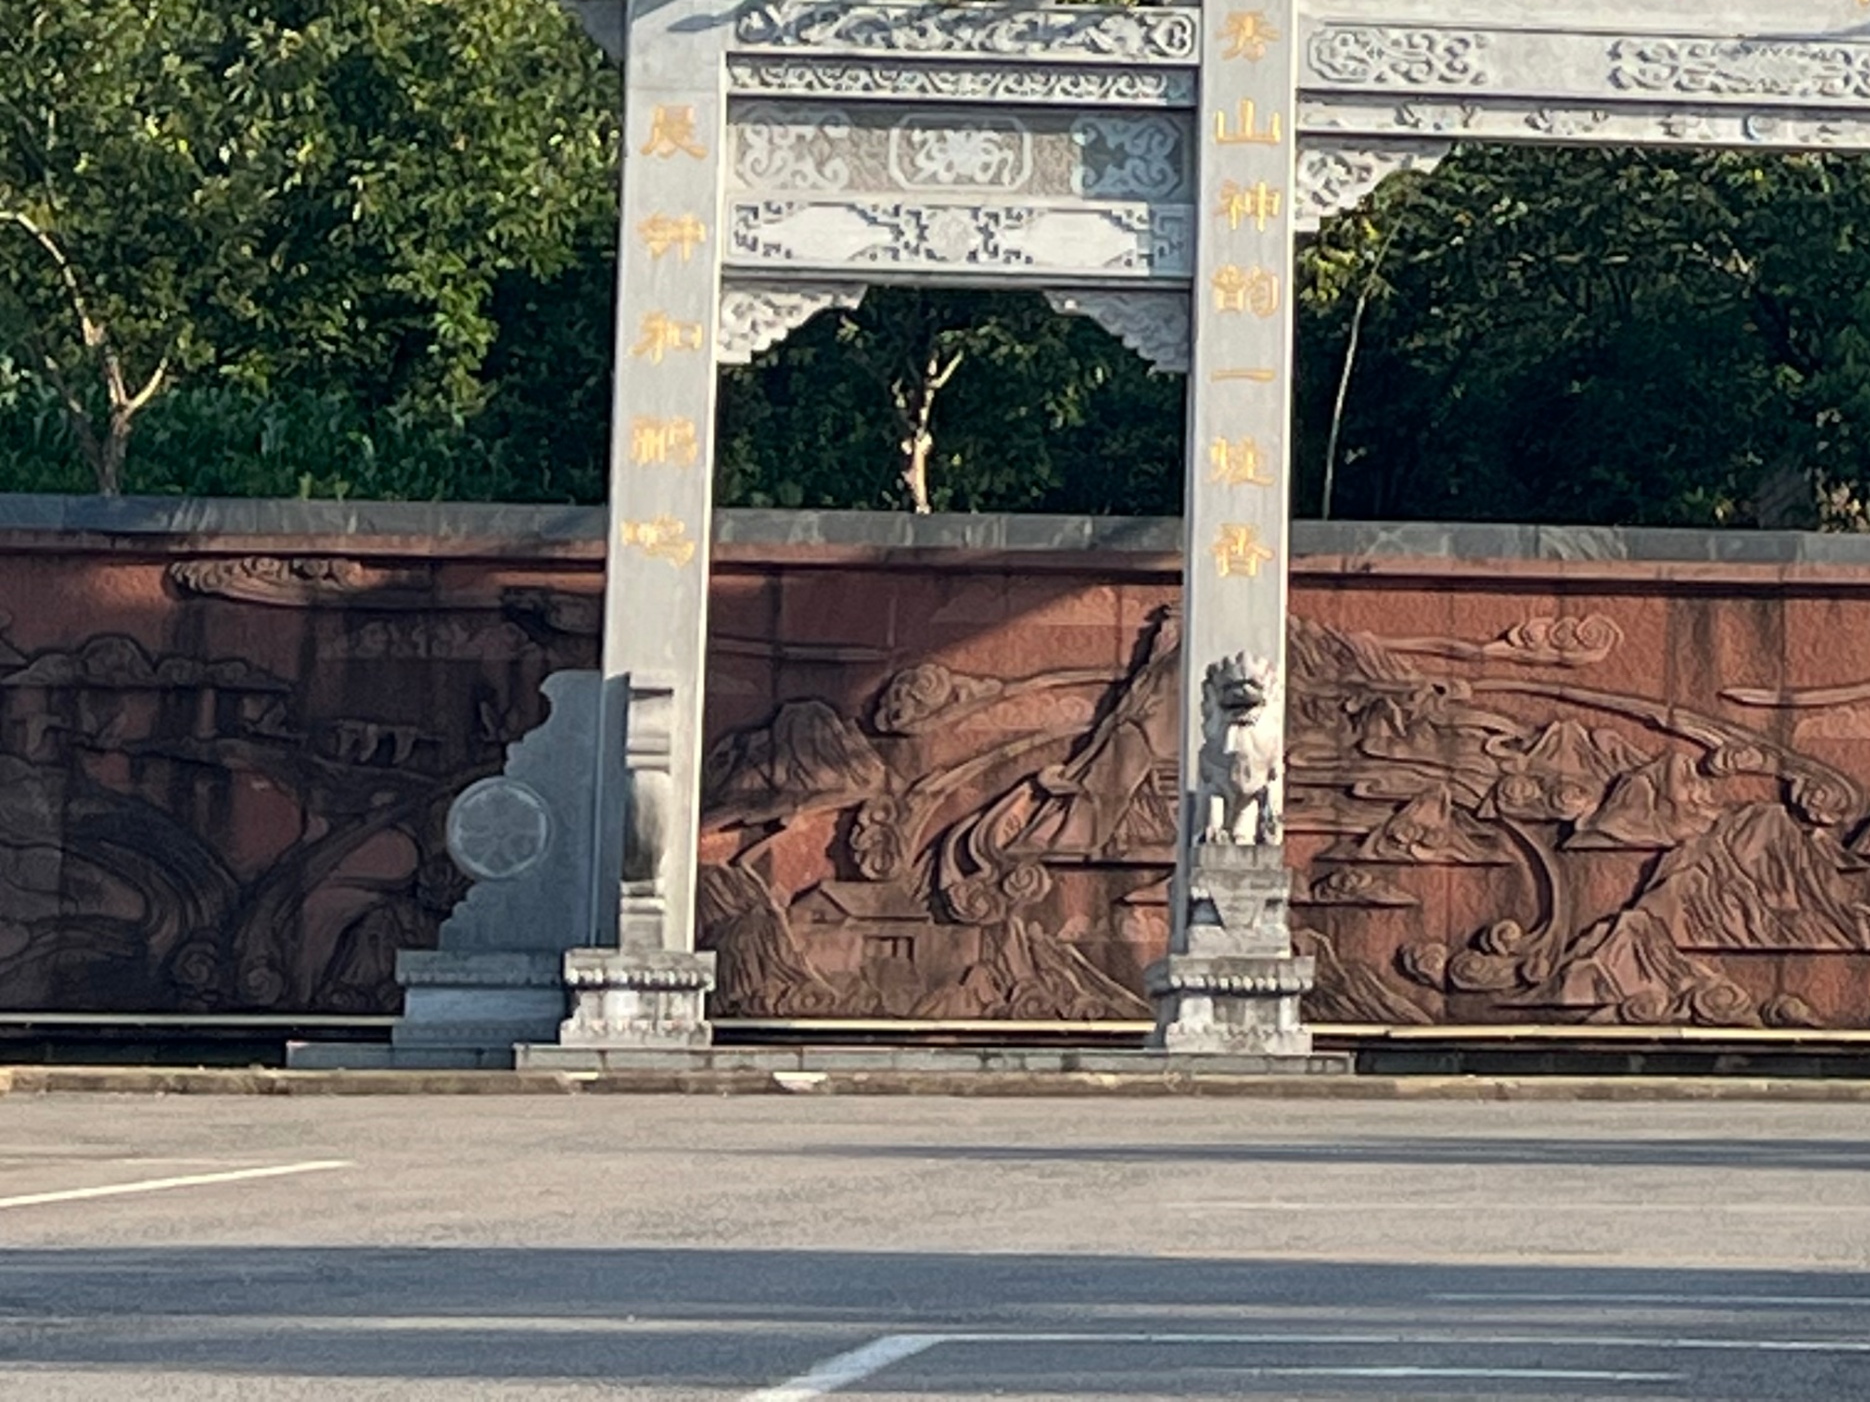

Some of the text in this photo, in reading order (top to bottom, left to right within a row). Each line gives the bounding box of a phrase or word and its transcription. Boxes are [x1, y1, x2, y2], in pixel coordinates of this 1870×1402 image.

[1209, 9, 1283, 579] 秀山神韵一炷香
